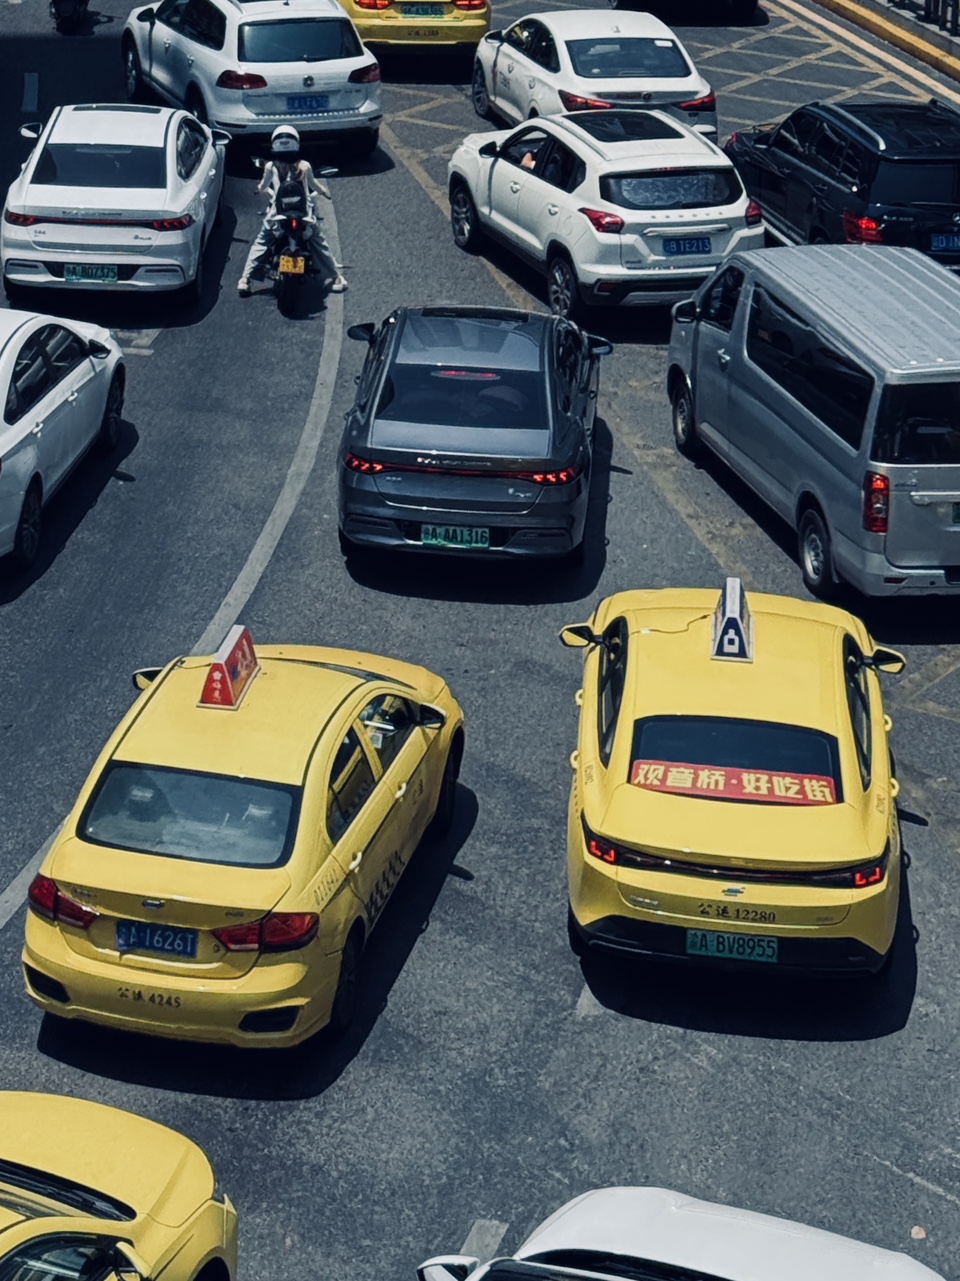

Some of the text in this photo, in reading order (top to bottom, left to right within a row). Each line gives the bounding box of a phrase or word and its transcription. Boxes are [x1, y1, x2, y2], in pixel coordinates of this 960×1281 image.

[634, 764, 834, 801] 观音桥·好吃街
